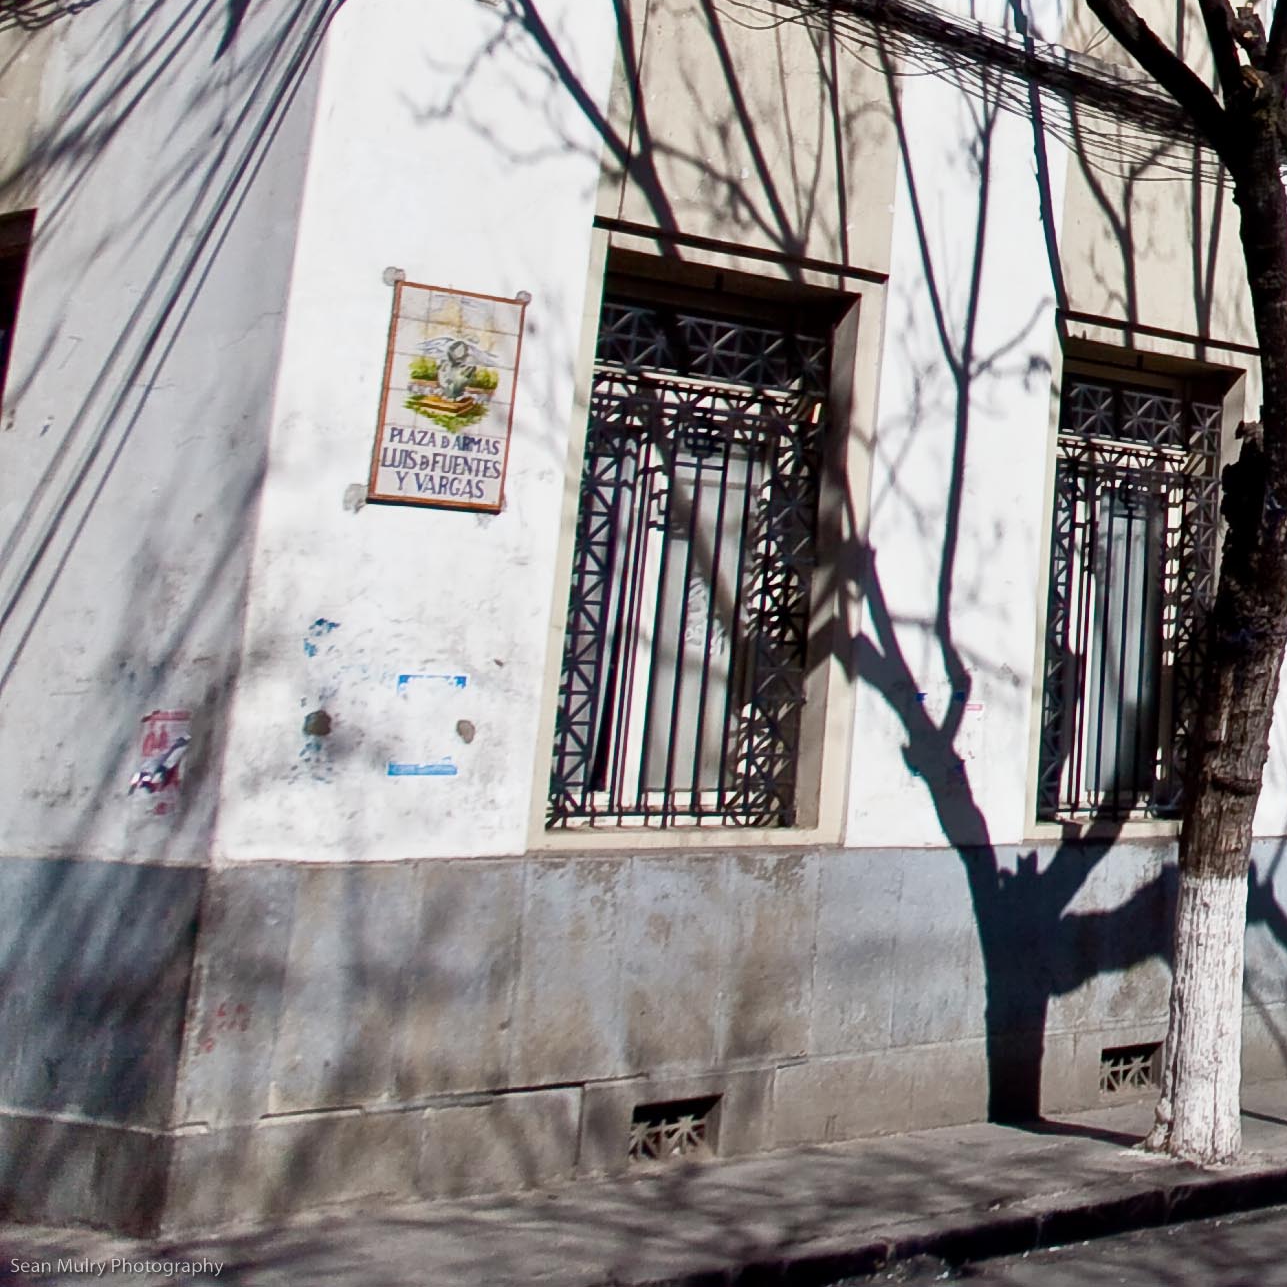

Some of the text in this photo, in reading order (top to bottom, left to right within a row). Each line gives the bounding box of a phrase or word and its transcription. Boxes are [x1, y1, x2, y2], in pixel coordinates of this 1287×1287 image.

[389, 427, 436, 447] PLAZA
[453, 434, 501, 456] ARMAS
[381, 447, 417, 470] LUIS
[431, 452, 502, 479] FUENTES
[395, 471, 485, 499] Y VARGAS
